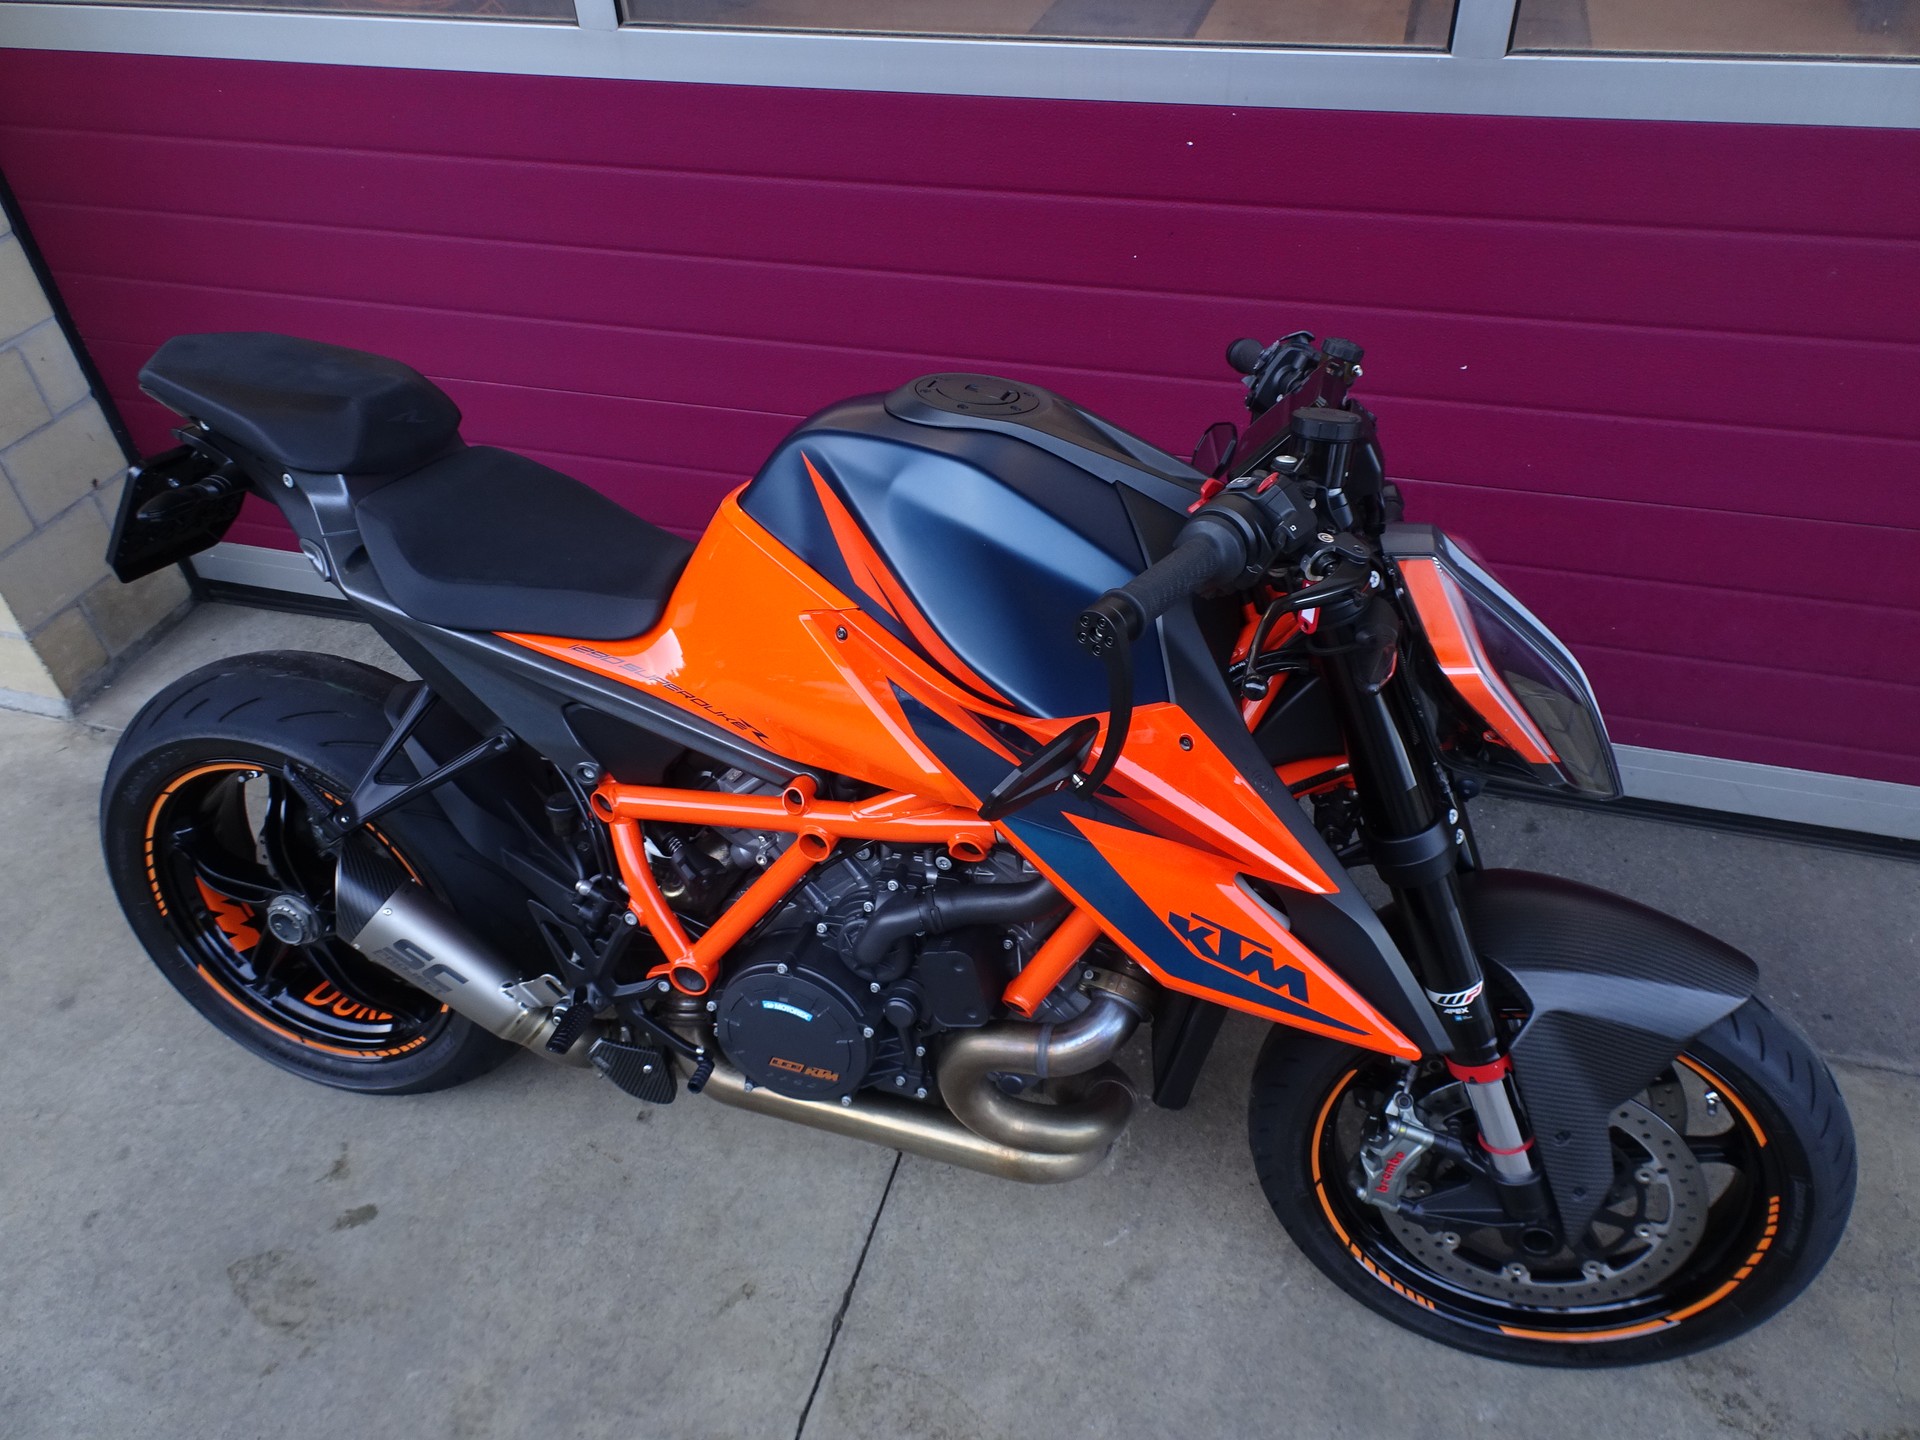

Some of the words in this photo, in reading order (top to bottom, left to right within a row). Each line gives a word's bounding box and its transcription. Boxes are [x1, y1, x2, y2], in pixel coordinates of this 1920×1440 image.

[383, 938, 470, 992] SC
[1168, 911, 1310, 1004] KTM
[1437, 985, 1482, 1005] WP
[804, 1066, 839, 1082] KTM
[1375, 1151, 1406, 1193] brembo
